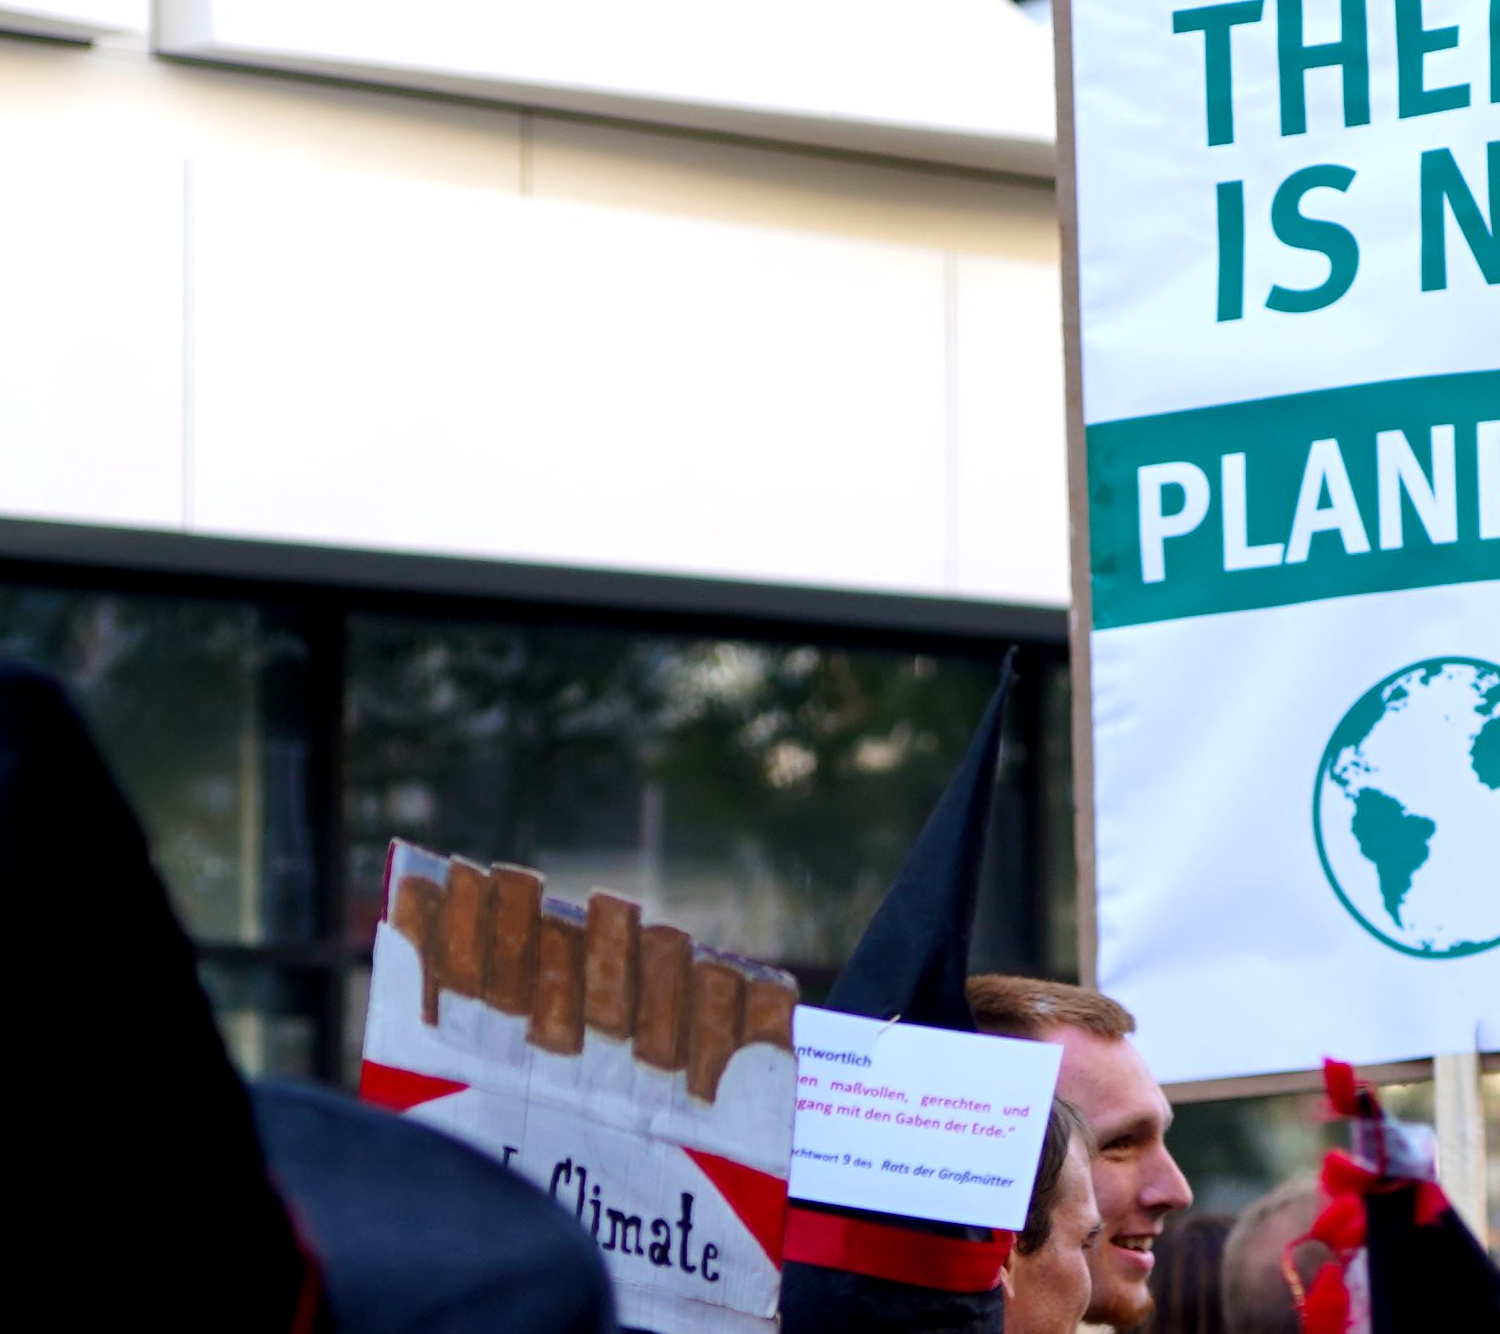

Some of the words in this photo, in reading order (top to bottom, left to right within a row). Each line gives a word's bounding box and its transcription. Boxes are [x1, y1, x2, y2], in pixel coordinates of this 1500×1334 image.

[1215, 163, 1360, 324] IS
[830, 1081, 909, 1104] maßvollen,
[920, 1095, 991, 1113] gerechten
[1003, 1106, 1030, 1118] und
[836, 1104, 861, 1118] mit
[864, 1108, 891, 1123] den
[895, 1112, 940, 1129] Gaben
[944, 1119, 968, 1134] der
[843, 1154, 851, 1165] 9
[853, 1157, 872, 1169] des
[881, 1159, 910, 1174] Rats
[913, 1165, 936, 1178] der
[938, 1168, 1015, 1187] Großmütter
[550, 1155, 720, 1283] Climate
